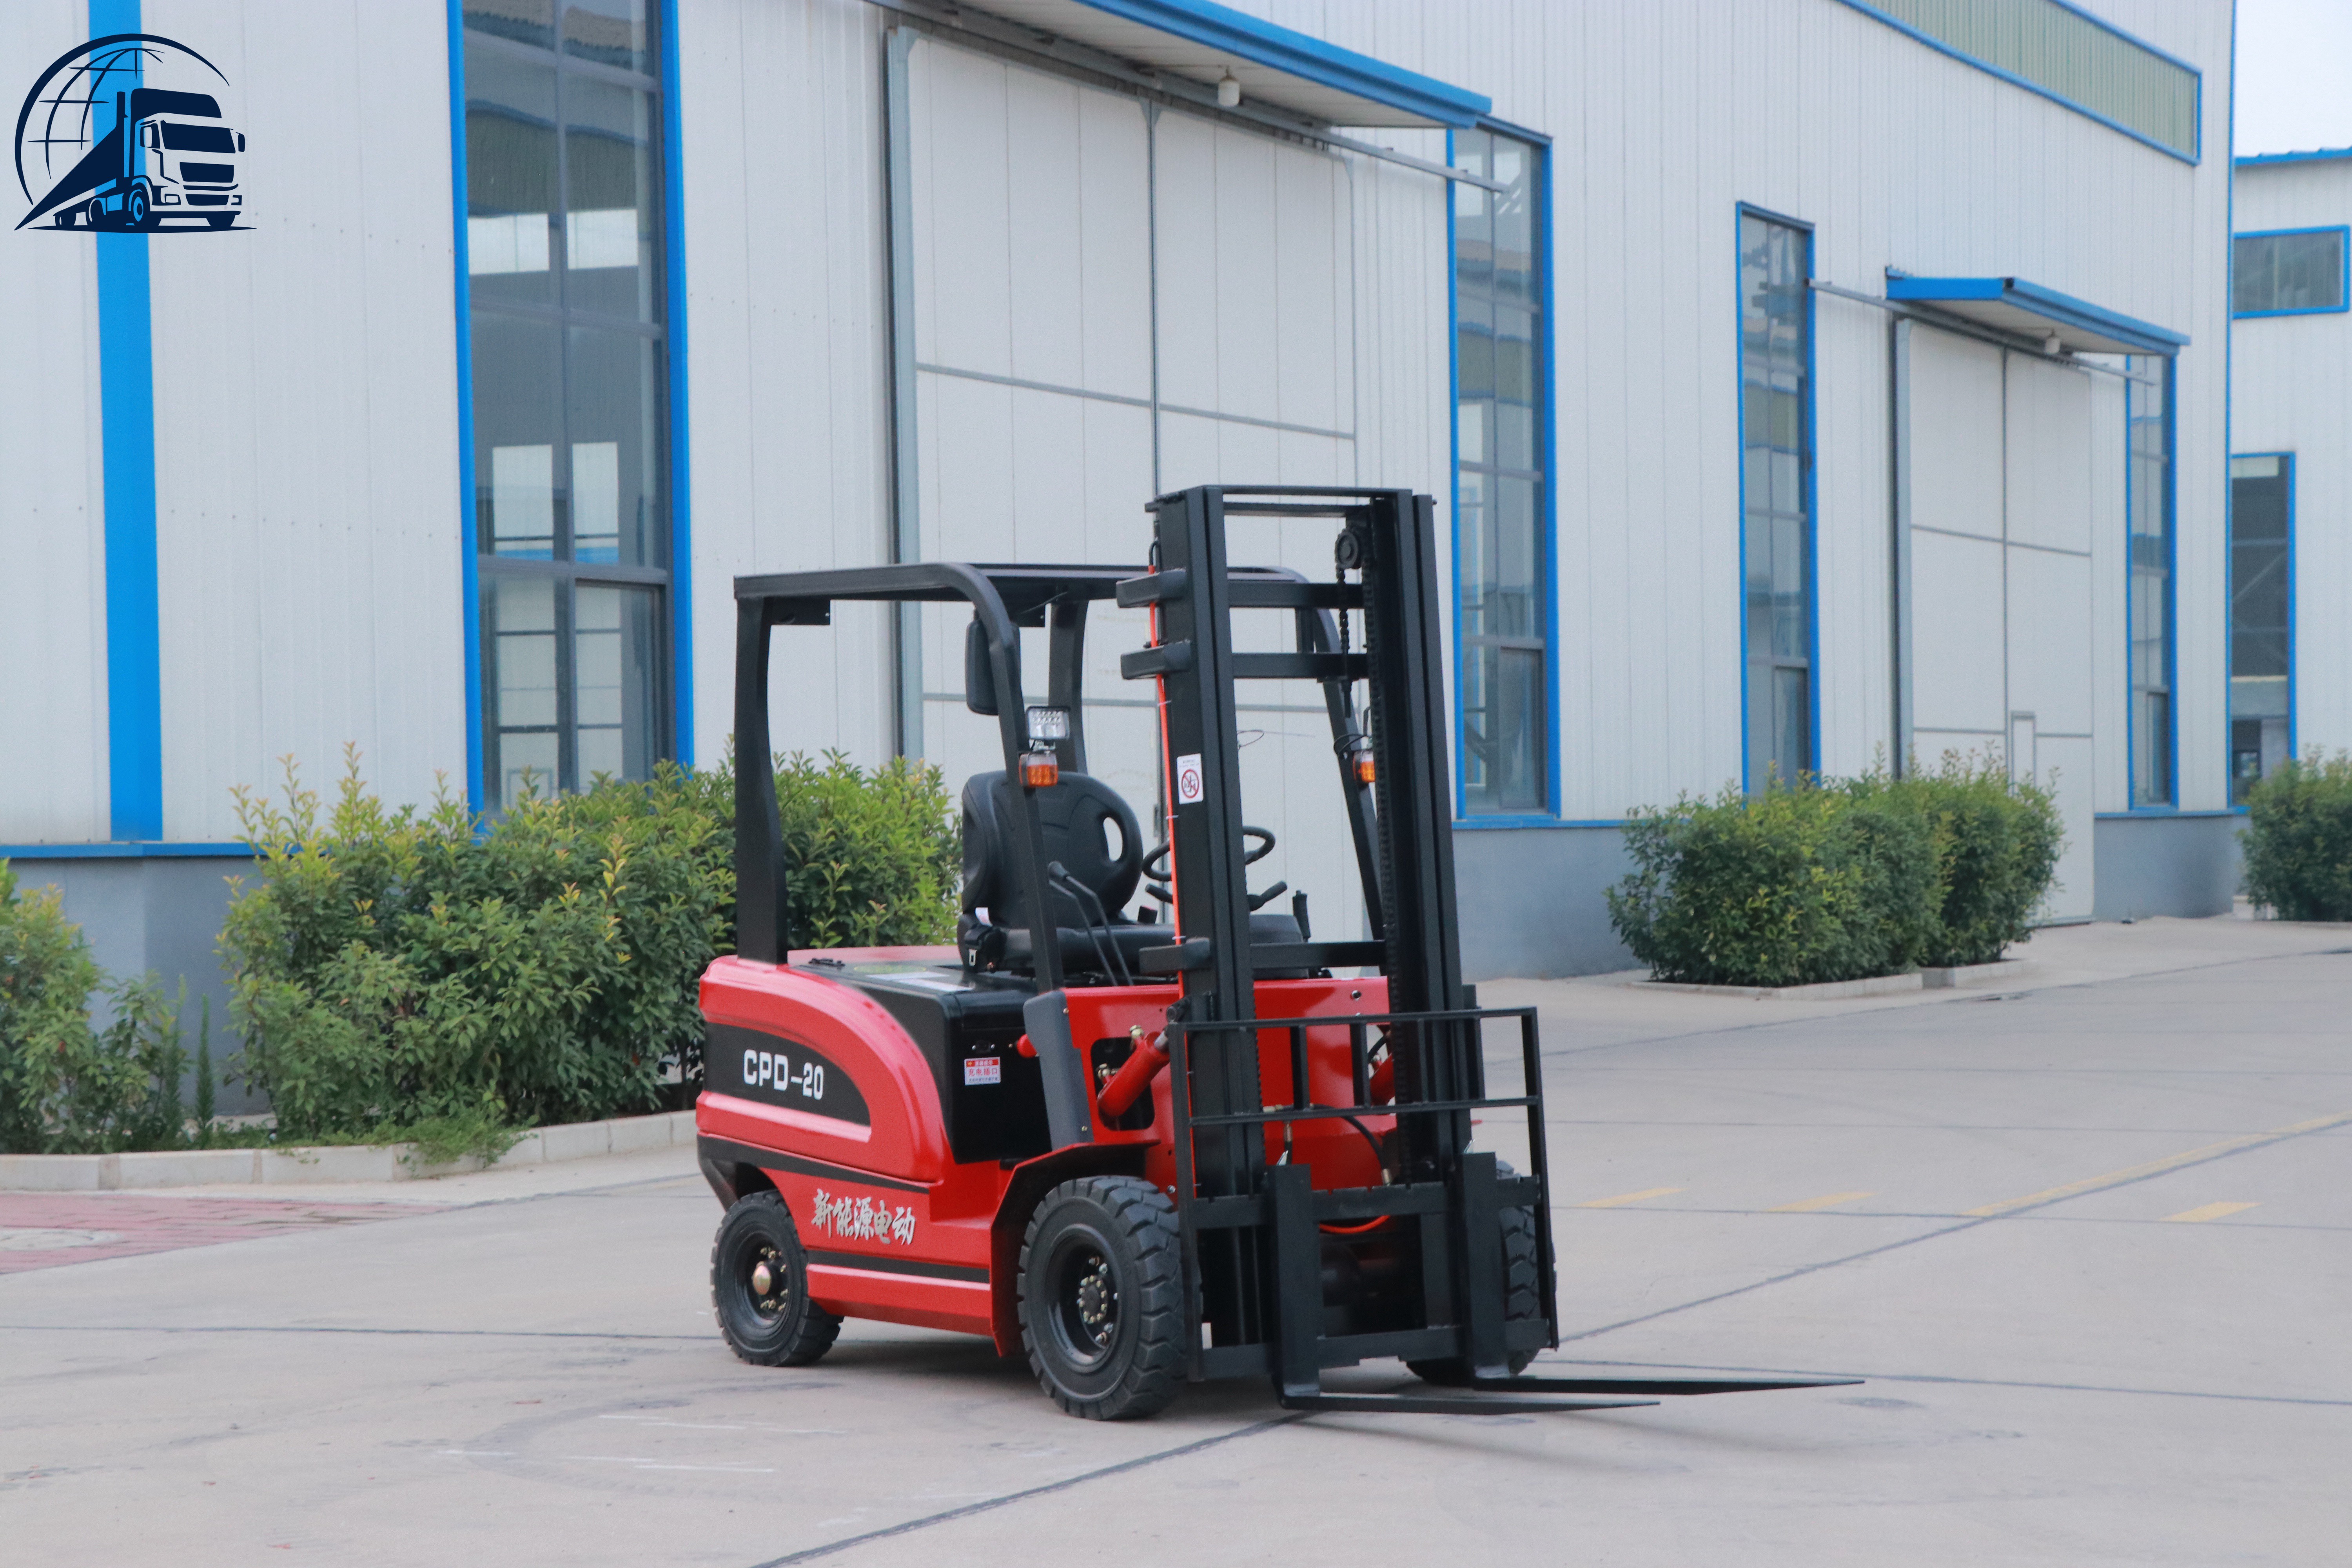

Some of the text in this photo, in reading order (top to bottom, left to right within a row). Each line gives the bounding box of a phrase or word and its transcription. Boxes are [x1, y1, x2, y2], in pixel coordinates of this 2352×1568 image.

[744, 1049, 824, 1100] CPD-20
[811, 1188, 915, 1245] 新能源电动
